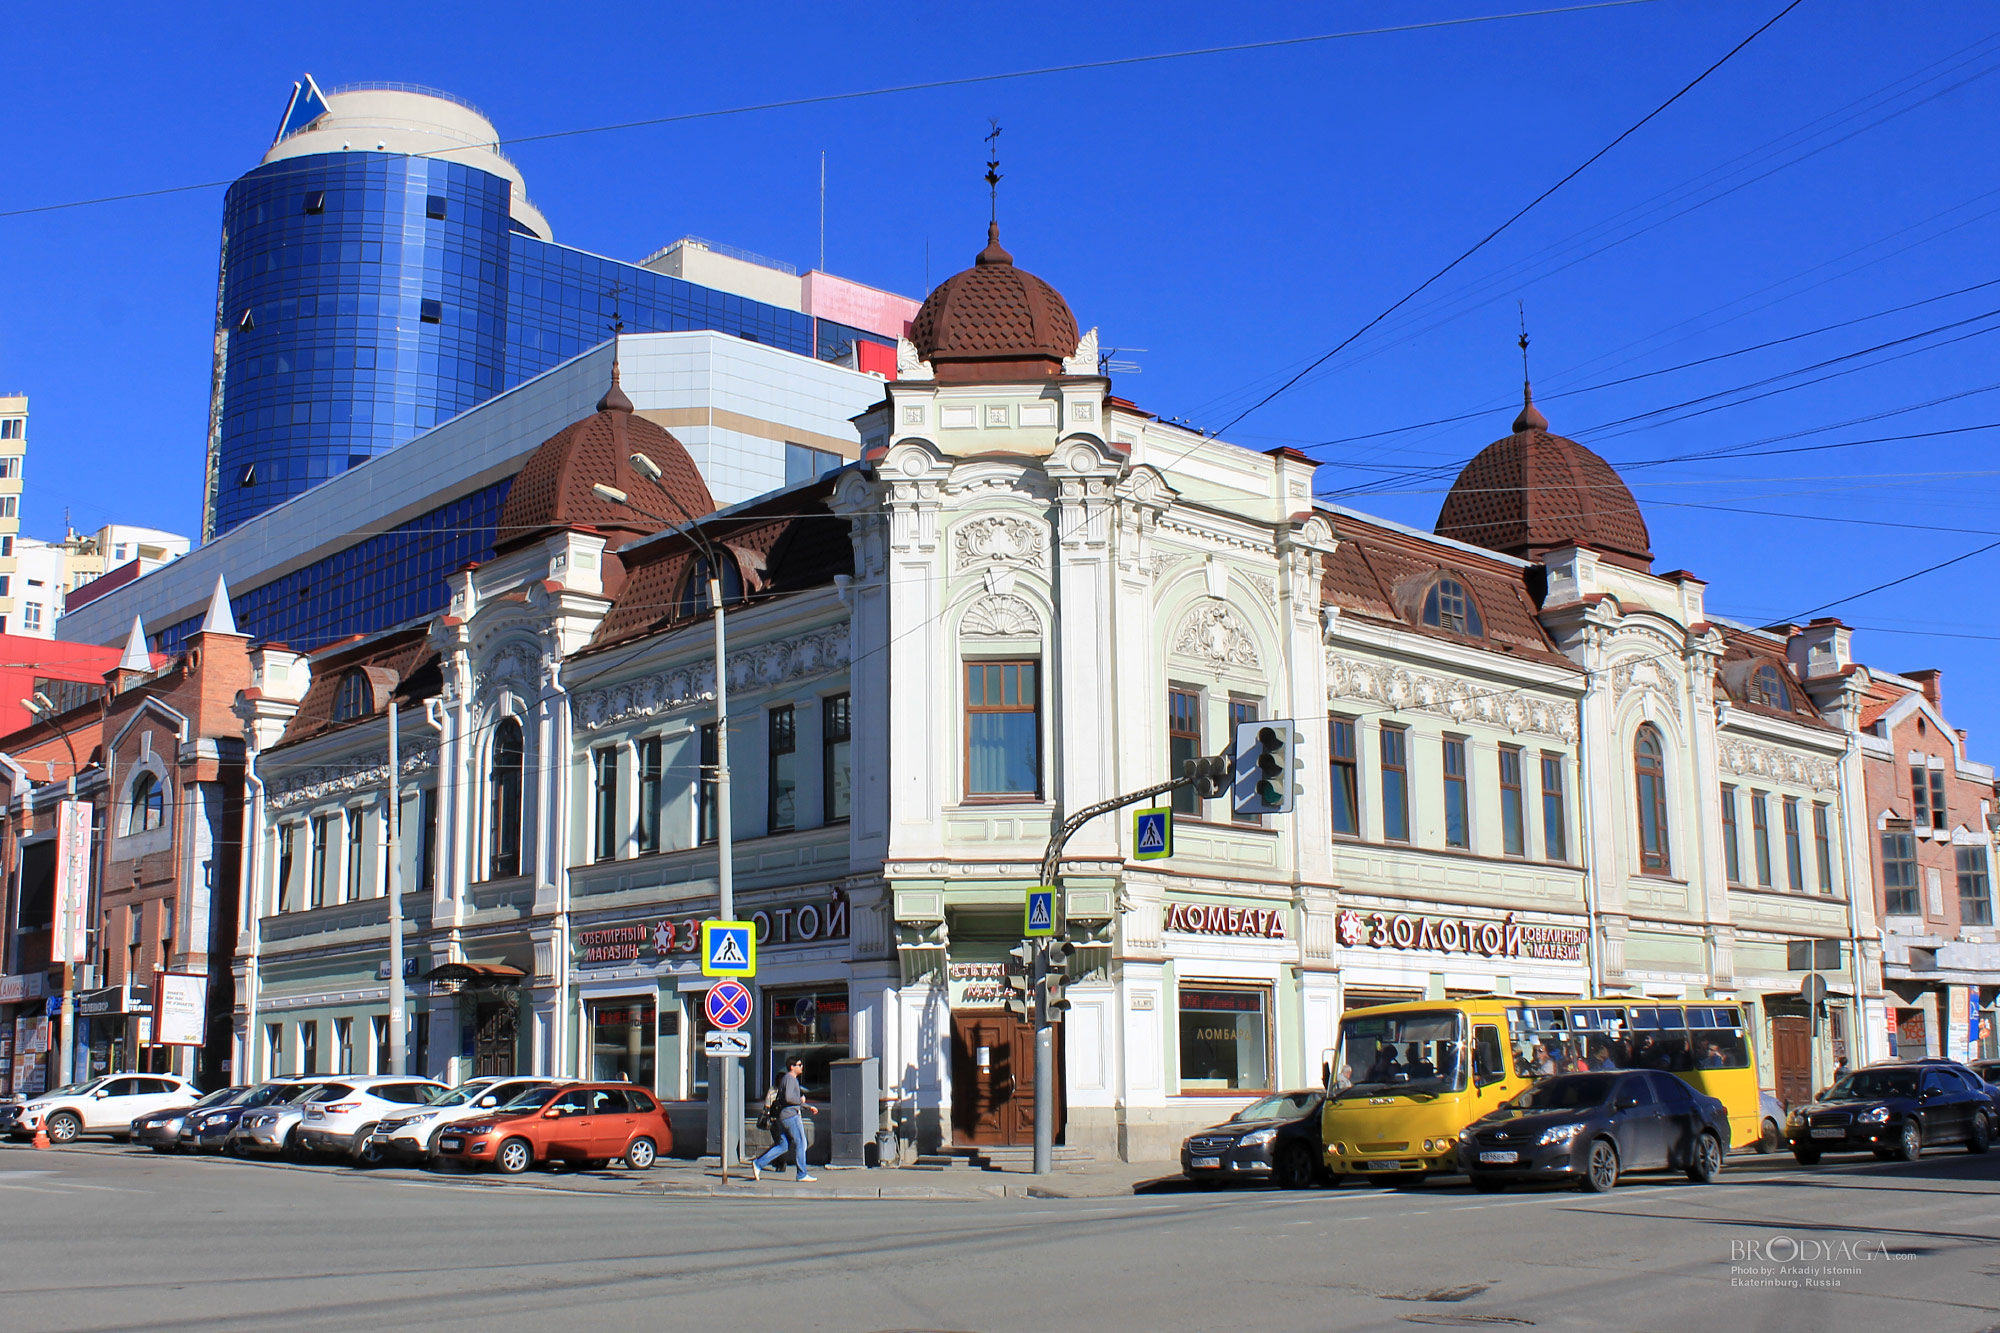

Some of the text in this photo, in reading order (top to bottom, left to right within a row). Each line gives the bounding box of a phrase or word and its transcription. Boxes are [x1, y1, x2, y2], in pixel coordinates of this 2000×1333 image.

[681, 887, 848, 953] ЗОТОЙ
[1168, 903, 1288, 938] ЛОМБАРД
[578, 923, 646, 946] ЮВЕЛИРНЫЙ
[1370, 912, 1521, 956] ЗОЛОТОЙ
[1522, 927, 1588, 944] ЮВЕЛИРНЫЙ
[586, 943, 639, 962] МАГАЗИН
[1533, 943, 1581, 961] МАГАЗИН
[407, 960, 414, 974] 2
[1196, 1028, 1253, 1040] ЛОМБАРД
